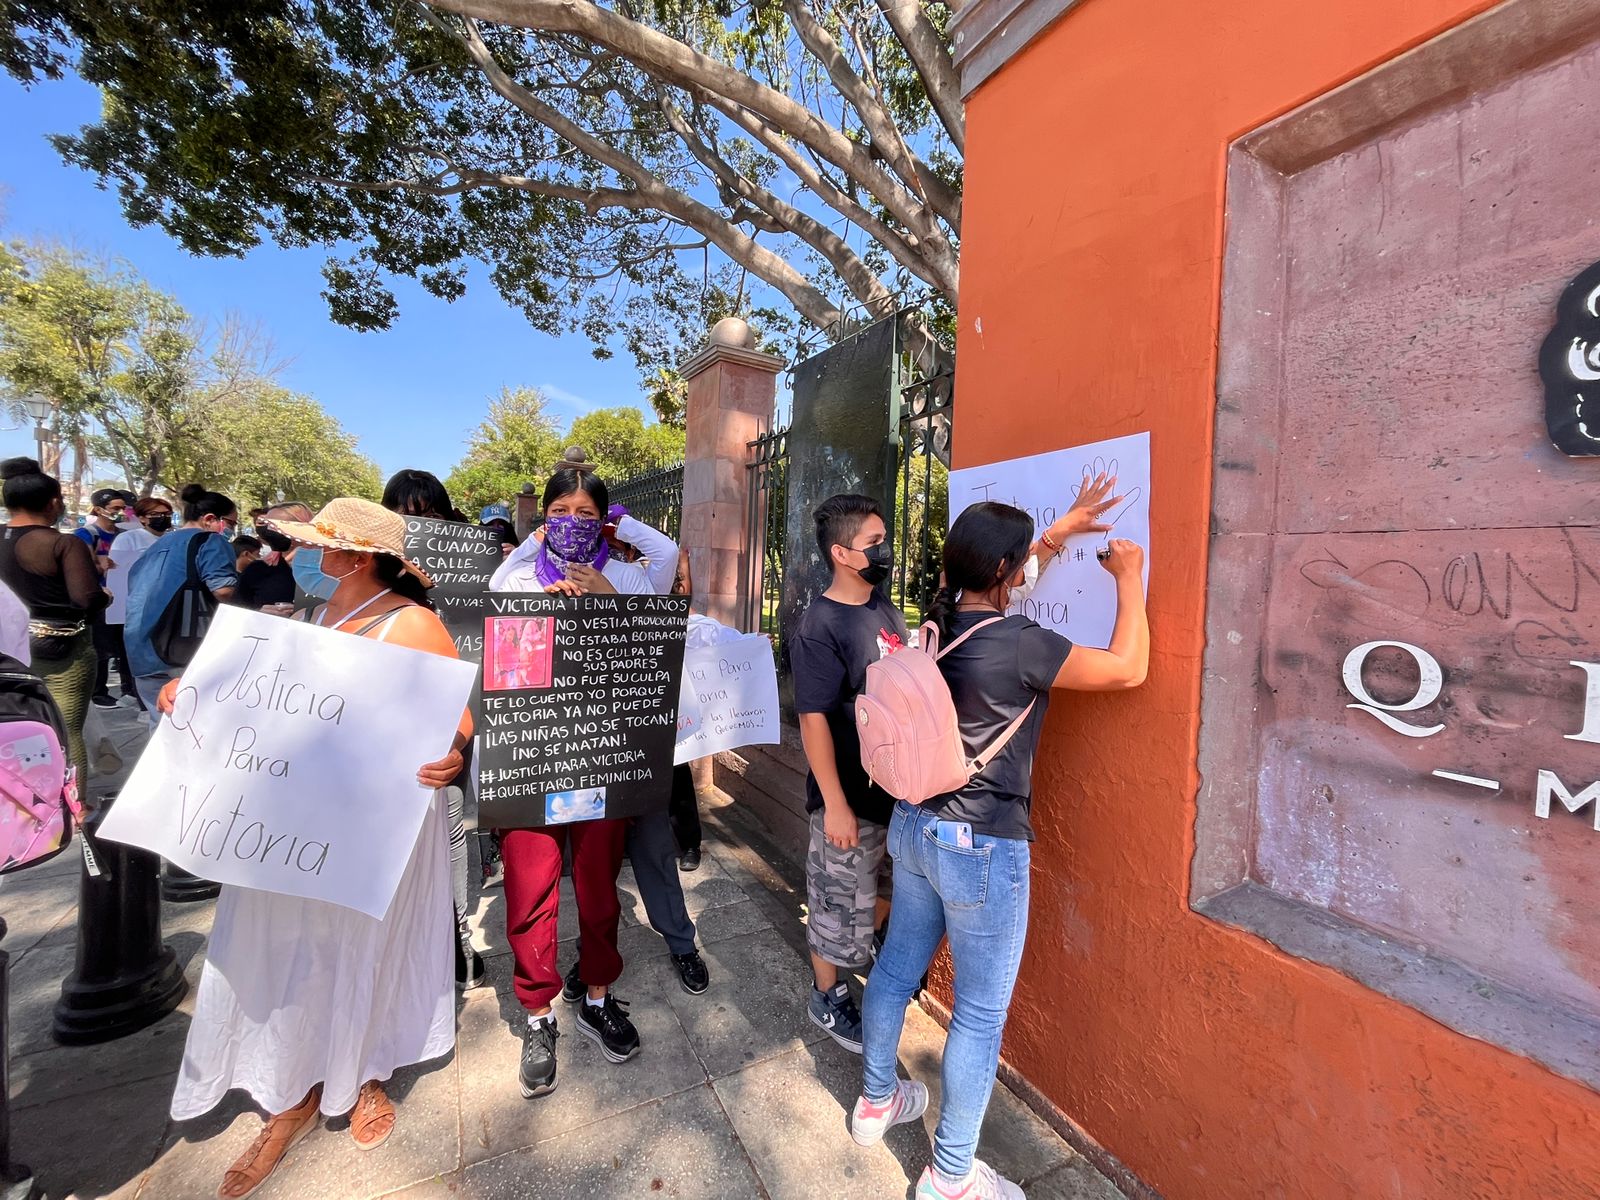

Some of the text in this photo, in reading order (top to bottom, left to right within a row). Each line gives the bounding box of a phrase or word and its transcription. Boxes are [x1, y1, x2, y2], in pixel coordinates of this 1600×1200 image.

[424, 521, 499, 541] SENTIRME
[426, 537, 498, 556] CUANDO
[426, 556, 478, 569] CALLE.
[430, 572, 491, 584] NTIRME
[490, 596, 687, 613] VICTORIA TENIA 6 AÑOS
[556, 616, 689, 632] NO VESTIA PROVOCATIVA
[555, 630, 687, 646] NO ESTABA BORRACHA
[562, 645, 664, 662] NO ES CULPA DE
[582, 657, 658, 673] SUS PADRES
[718, 658, 753, 677] Para
[215, 635, 345, 725] Justicia
[554, 675, 577, 688] NO
[581, 674, 609, 686] FUE
[483, 685, 667, 711] TE LO CUENTO YO PORQUE
[485, 698, 663, 727] VICTORIA YA NO PUEDE
[521, 725, 569, 742] NIÑAS
[574, 722, 598, 736] NO
[600, 718, 621, 733] SE
[624, 708, 674, 728] TOCAN!
[224, 726, 290, 778] Para
[544, 742, 562, 757] SE
[565, 733, 627, 754] MATAN!
[480, 749, 646, 784] #JUSTICIA PARA VICTORIA
[480, 767, 653, 802] #QUERETARO FEMINICIDA
